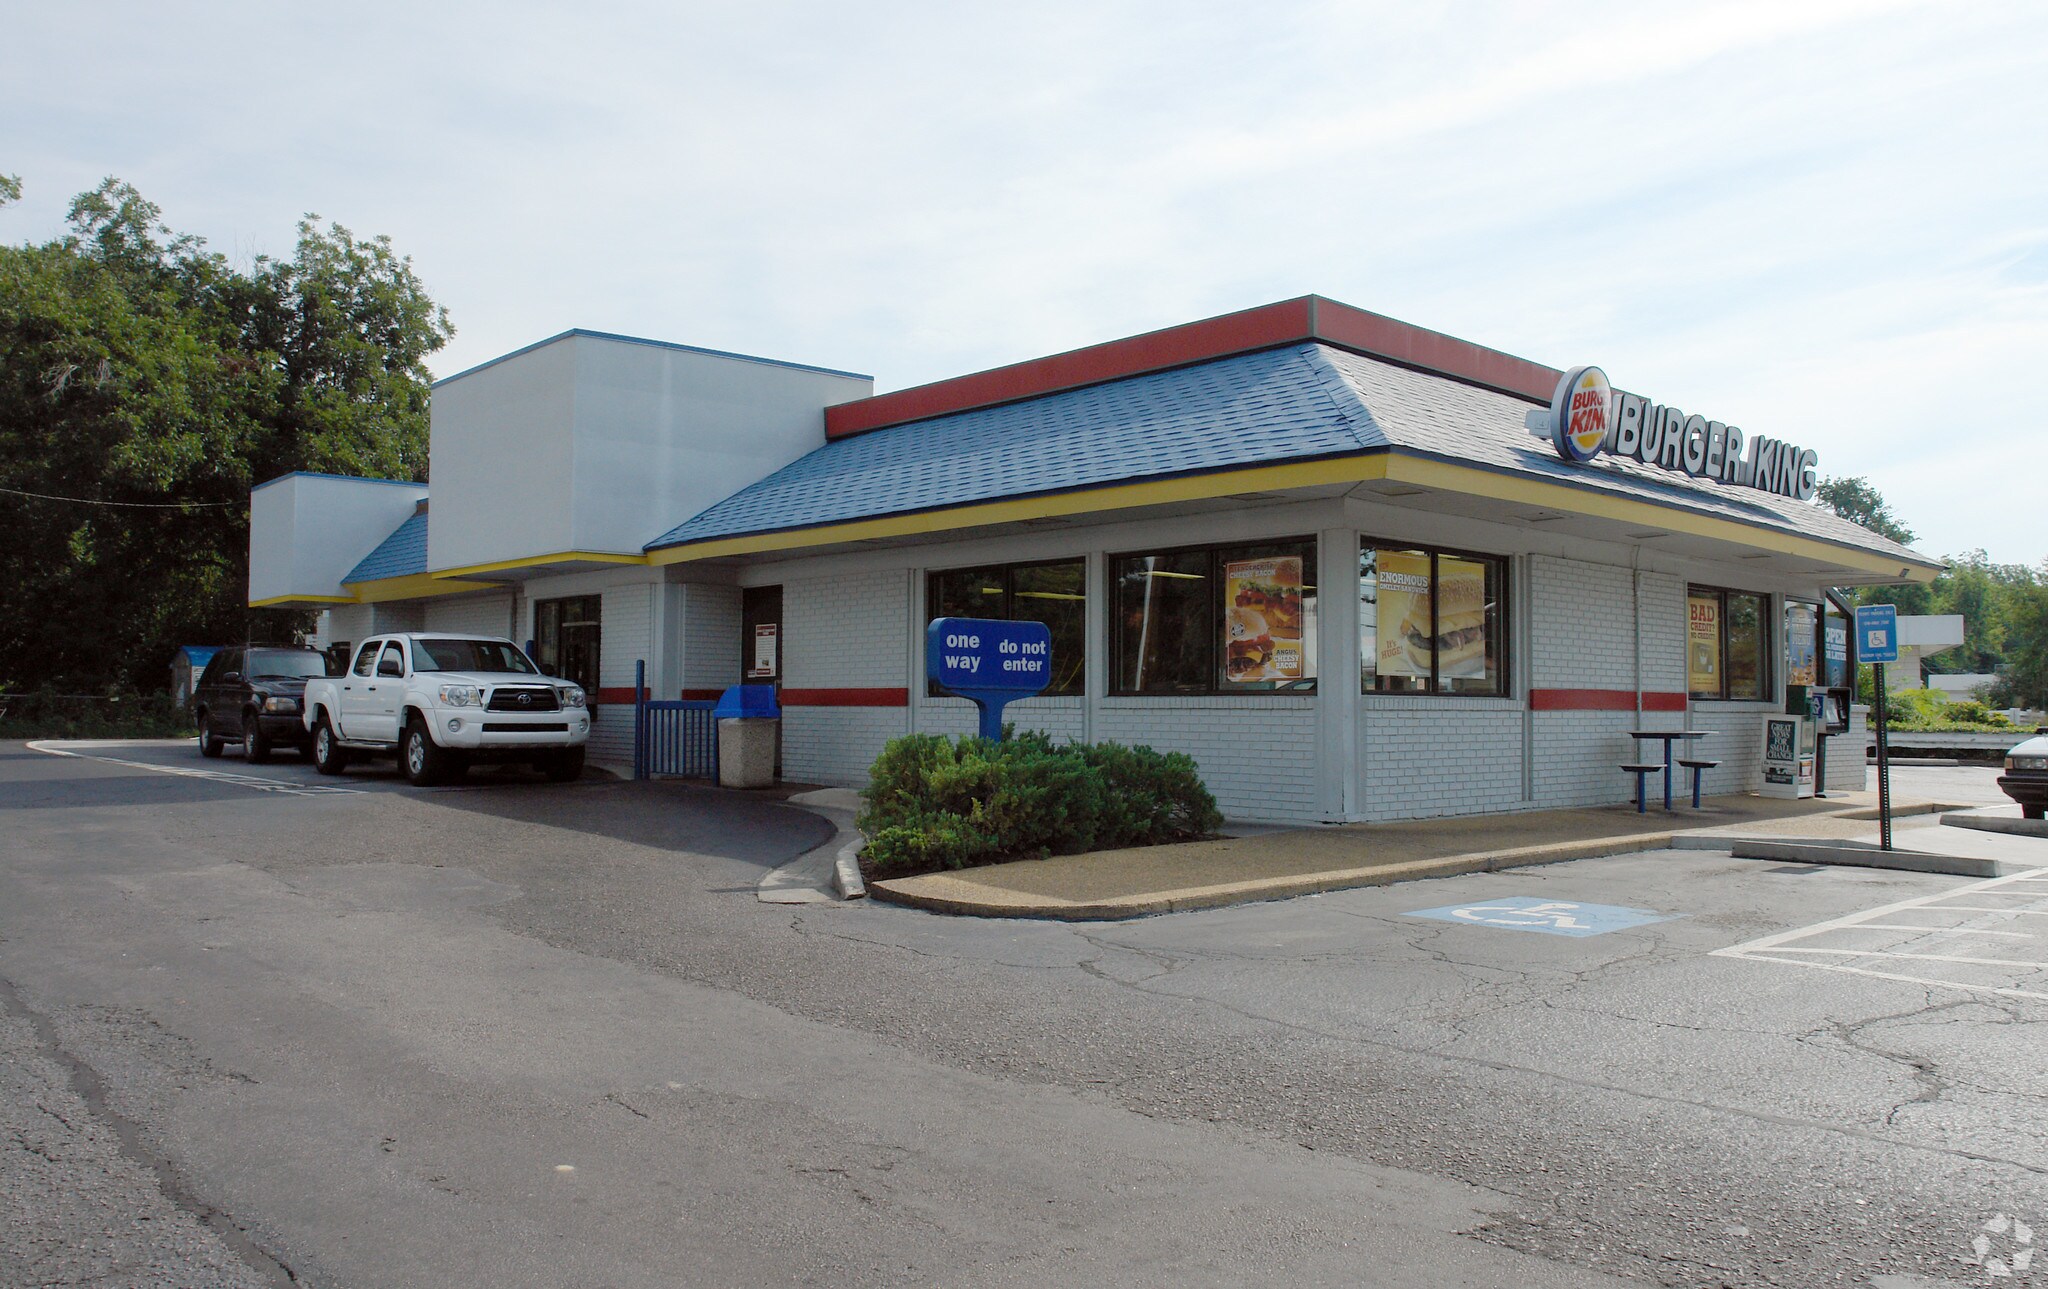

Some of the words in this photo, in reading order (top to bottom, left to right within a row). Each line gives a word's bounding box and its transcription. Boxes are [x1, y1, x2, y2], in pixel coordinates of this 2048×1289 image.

[1616, 394, 1743, 483] BURGER
[1753, 434, 1818, 501] KING
[1379, 571, 1428, 588] ENORMOUS
[1690, 603, 1715, 623] BAD
[1690, 621, 1715, 633] CREDIT?
[946, 634, 980, 649] one
[999, 639, 1018, 653] do
[1022, 640, 1046, 655] not
[1380, 645, 1403, 660] HUGE!
[945, 655, 981, 673] way
[1003, 657, 1042, 672] enter
[1275, 661, 1298, 670] BACON
[1771, 723, 1792, 732] GREAT
[1771, 729, 1790, 739] NEWS
[1769, 744, 1790, 752] SMALL
[1774, 738, 1787, 746] FOR
[1767, 751, 1793, 760] CHANGE
